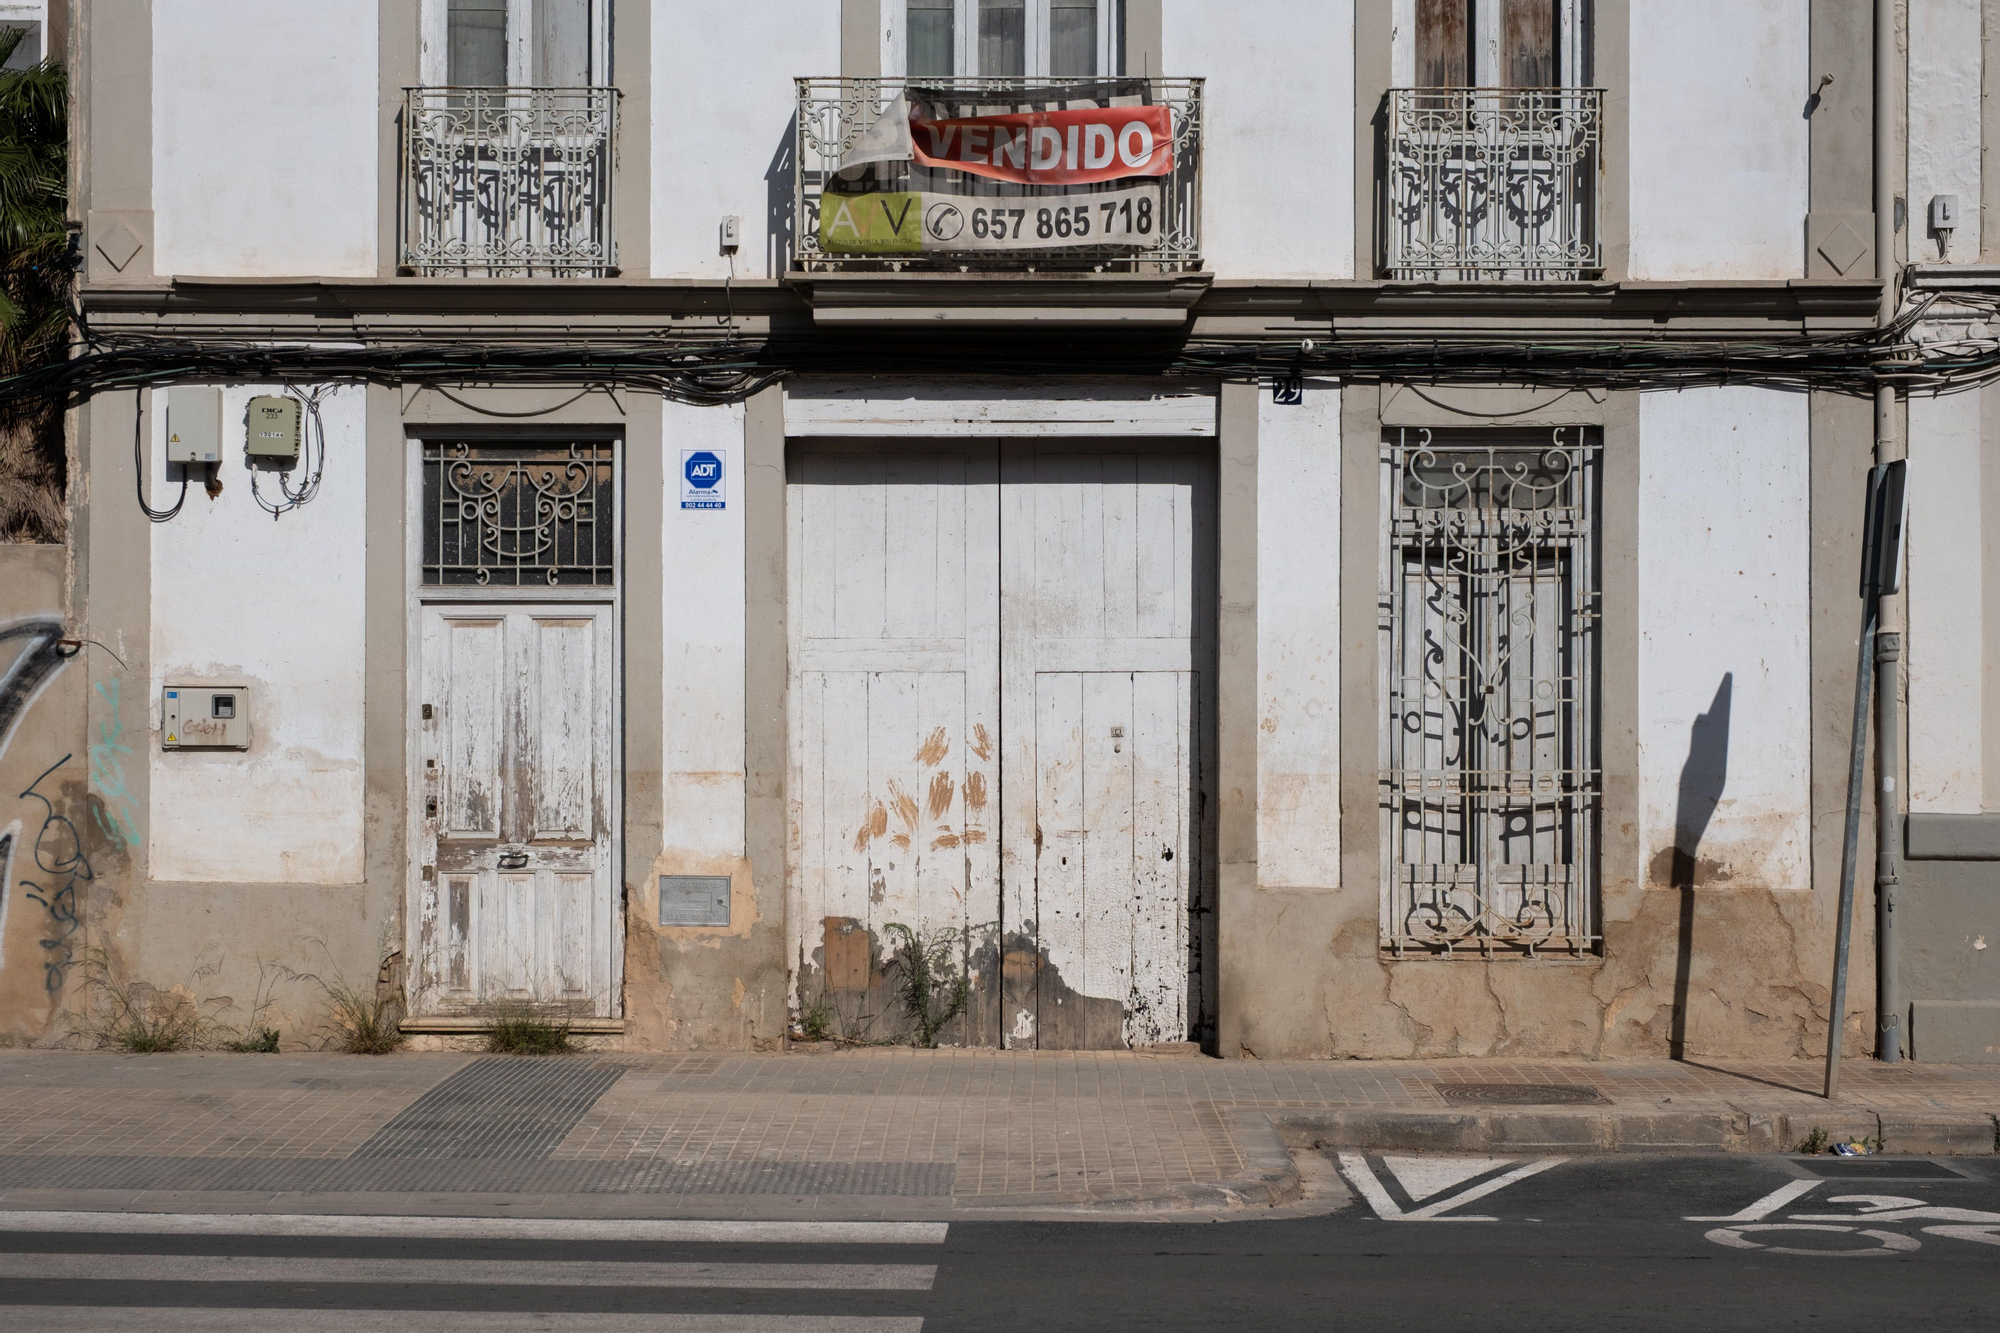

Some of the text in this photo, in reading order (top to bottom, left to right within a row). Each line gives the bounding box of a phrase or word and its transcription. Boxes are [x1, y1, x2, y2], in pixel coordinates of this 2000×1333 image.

[926, 120, 1155, 170] VENDIDO
[971, 195, 1153, 240] 657 865 718
[1273, 378, 1301, 403] 29
[691, 464, 717, 477] ADT
[667, 913, 689, 921] LLAVE
[692, 913, 702, 921] DE
